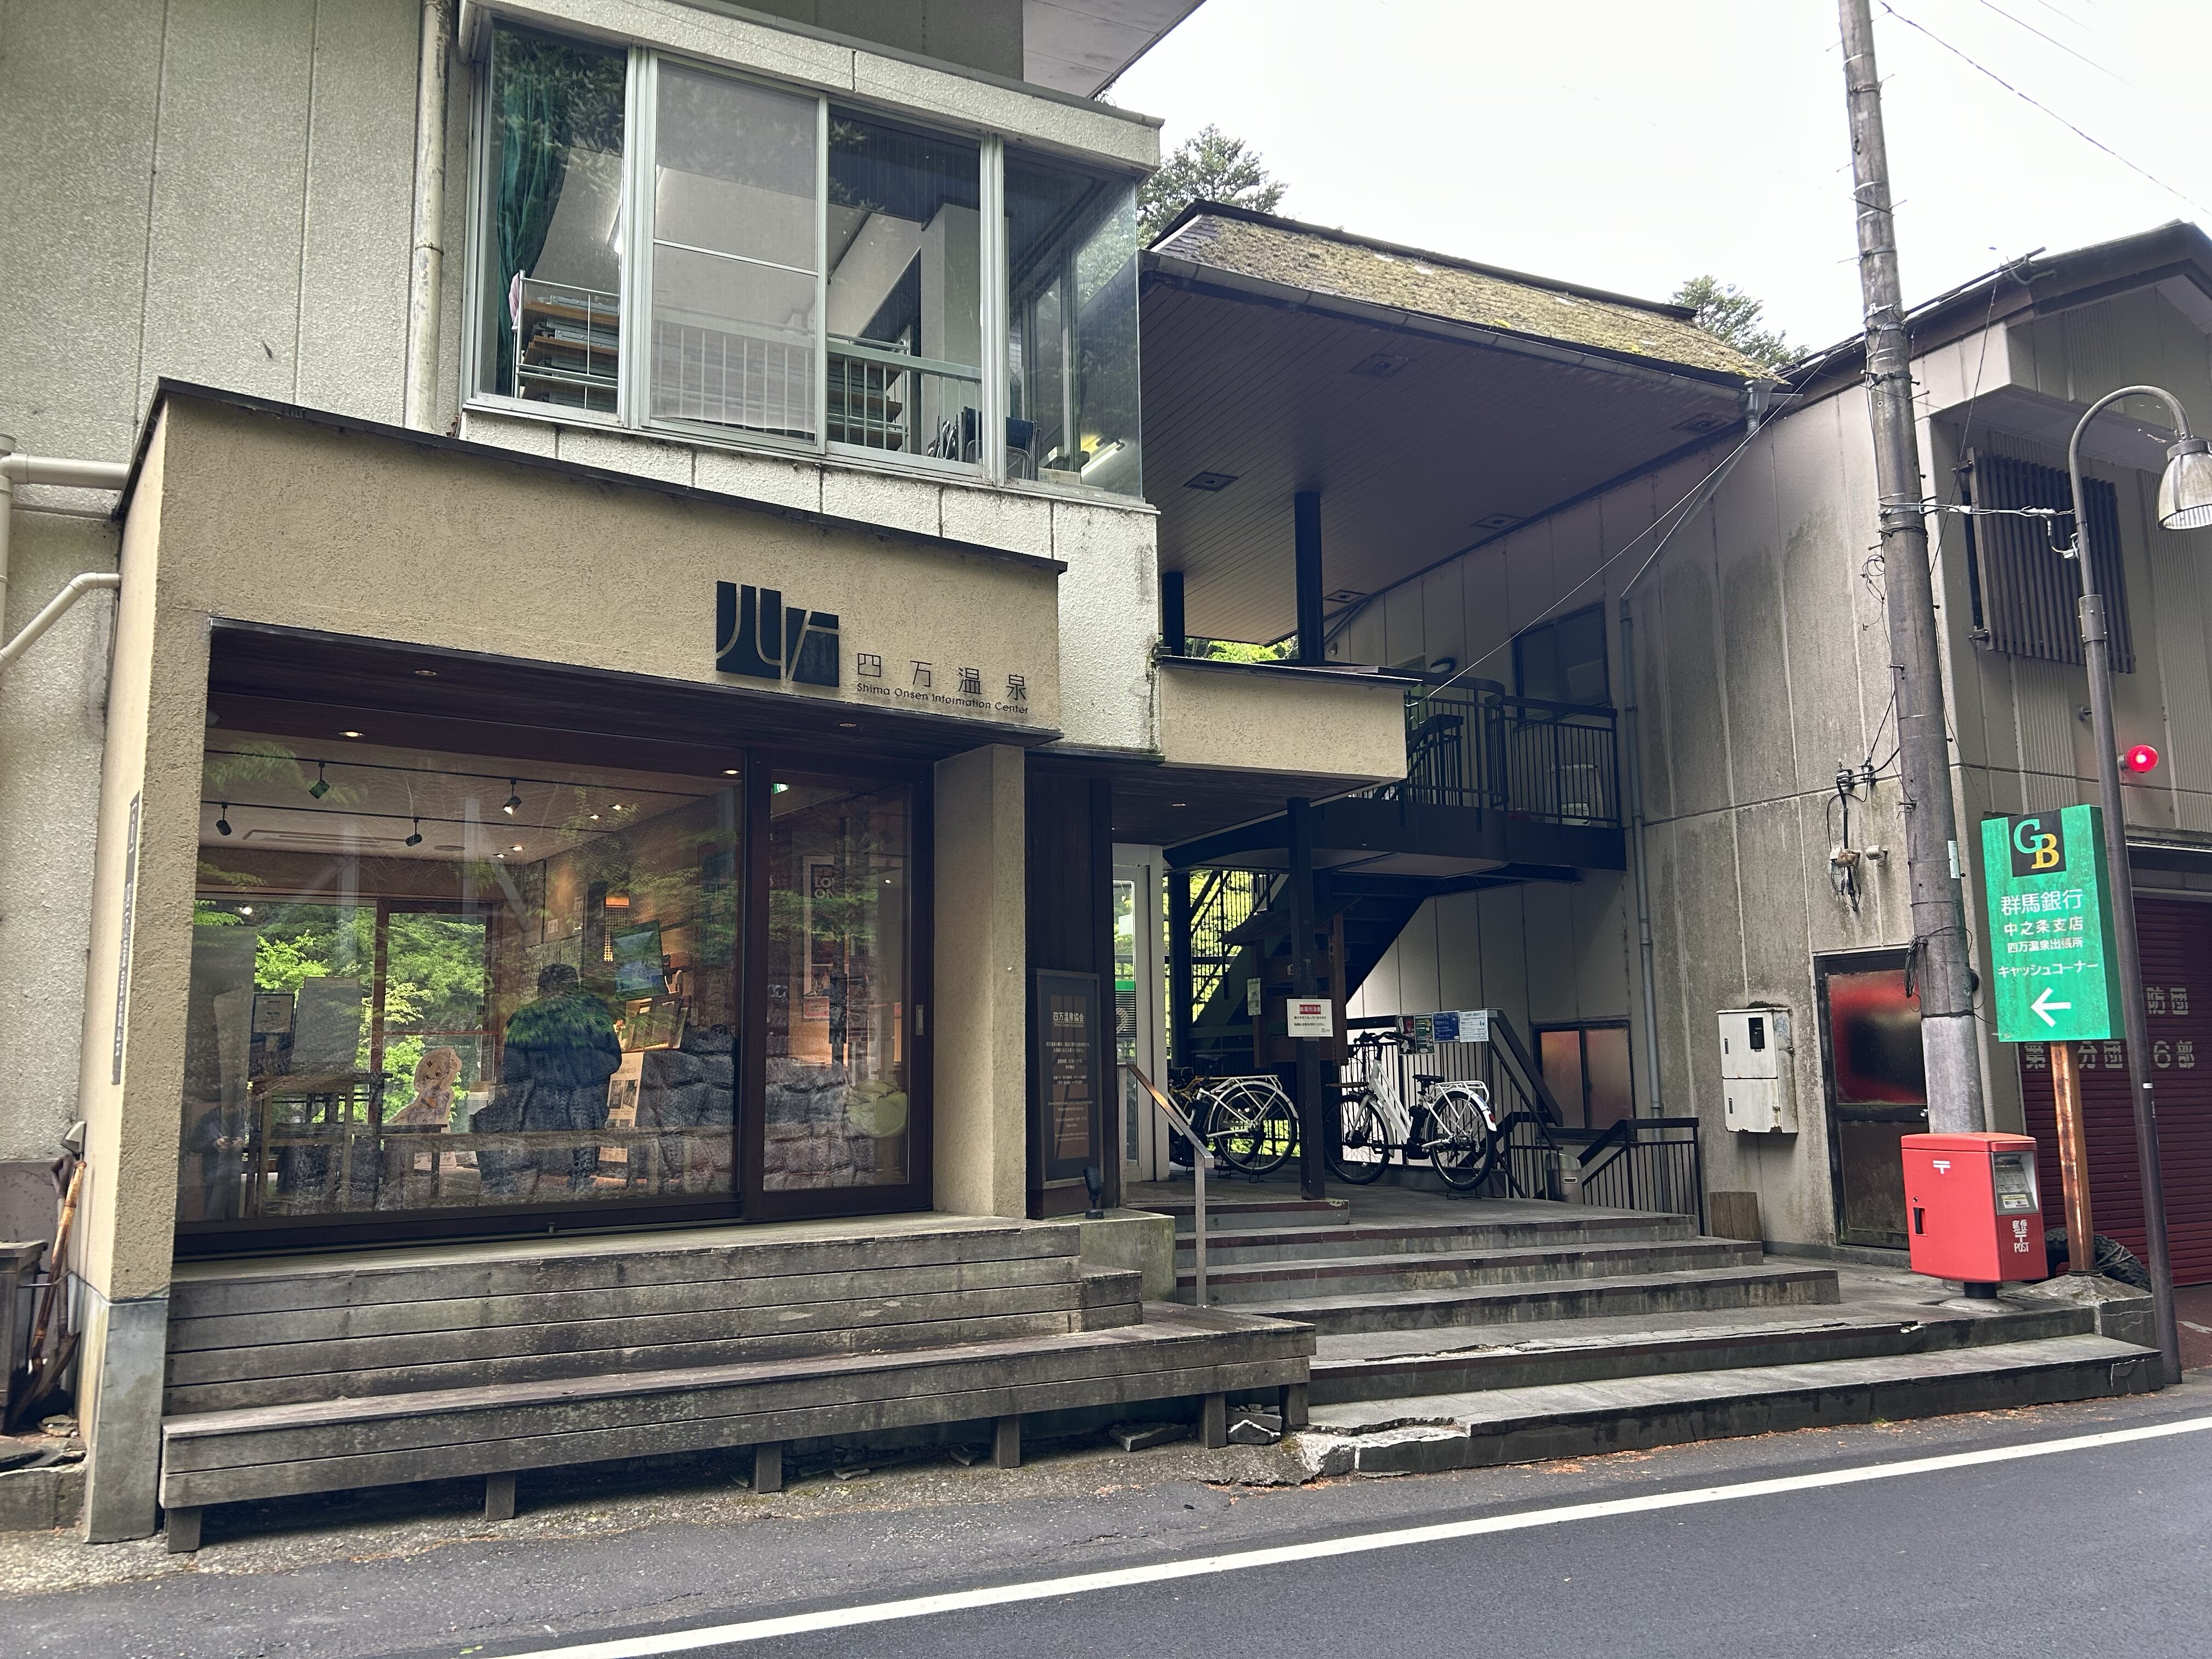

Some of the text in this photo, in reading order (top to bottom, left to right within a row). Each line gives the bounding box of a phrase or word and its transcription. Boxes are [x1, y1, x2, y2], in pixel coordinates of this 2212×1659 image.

[857, 653, 1027, 701] 四万温泉
[856, 682, 1029, 714] Shima Onsen Information Center
[2013, 819, 2059, 869] GB
[2001, 889, 2083, 916] 群馬銀行
[2004, 916, 2084, 936] 中之条支店
[2007, 937, 2083, 953] 四万温泉出張所
[1998, 960, 2098, 978] キャッシュコーナー
[2014, 1242, 2029, 1253] POST
